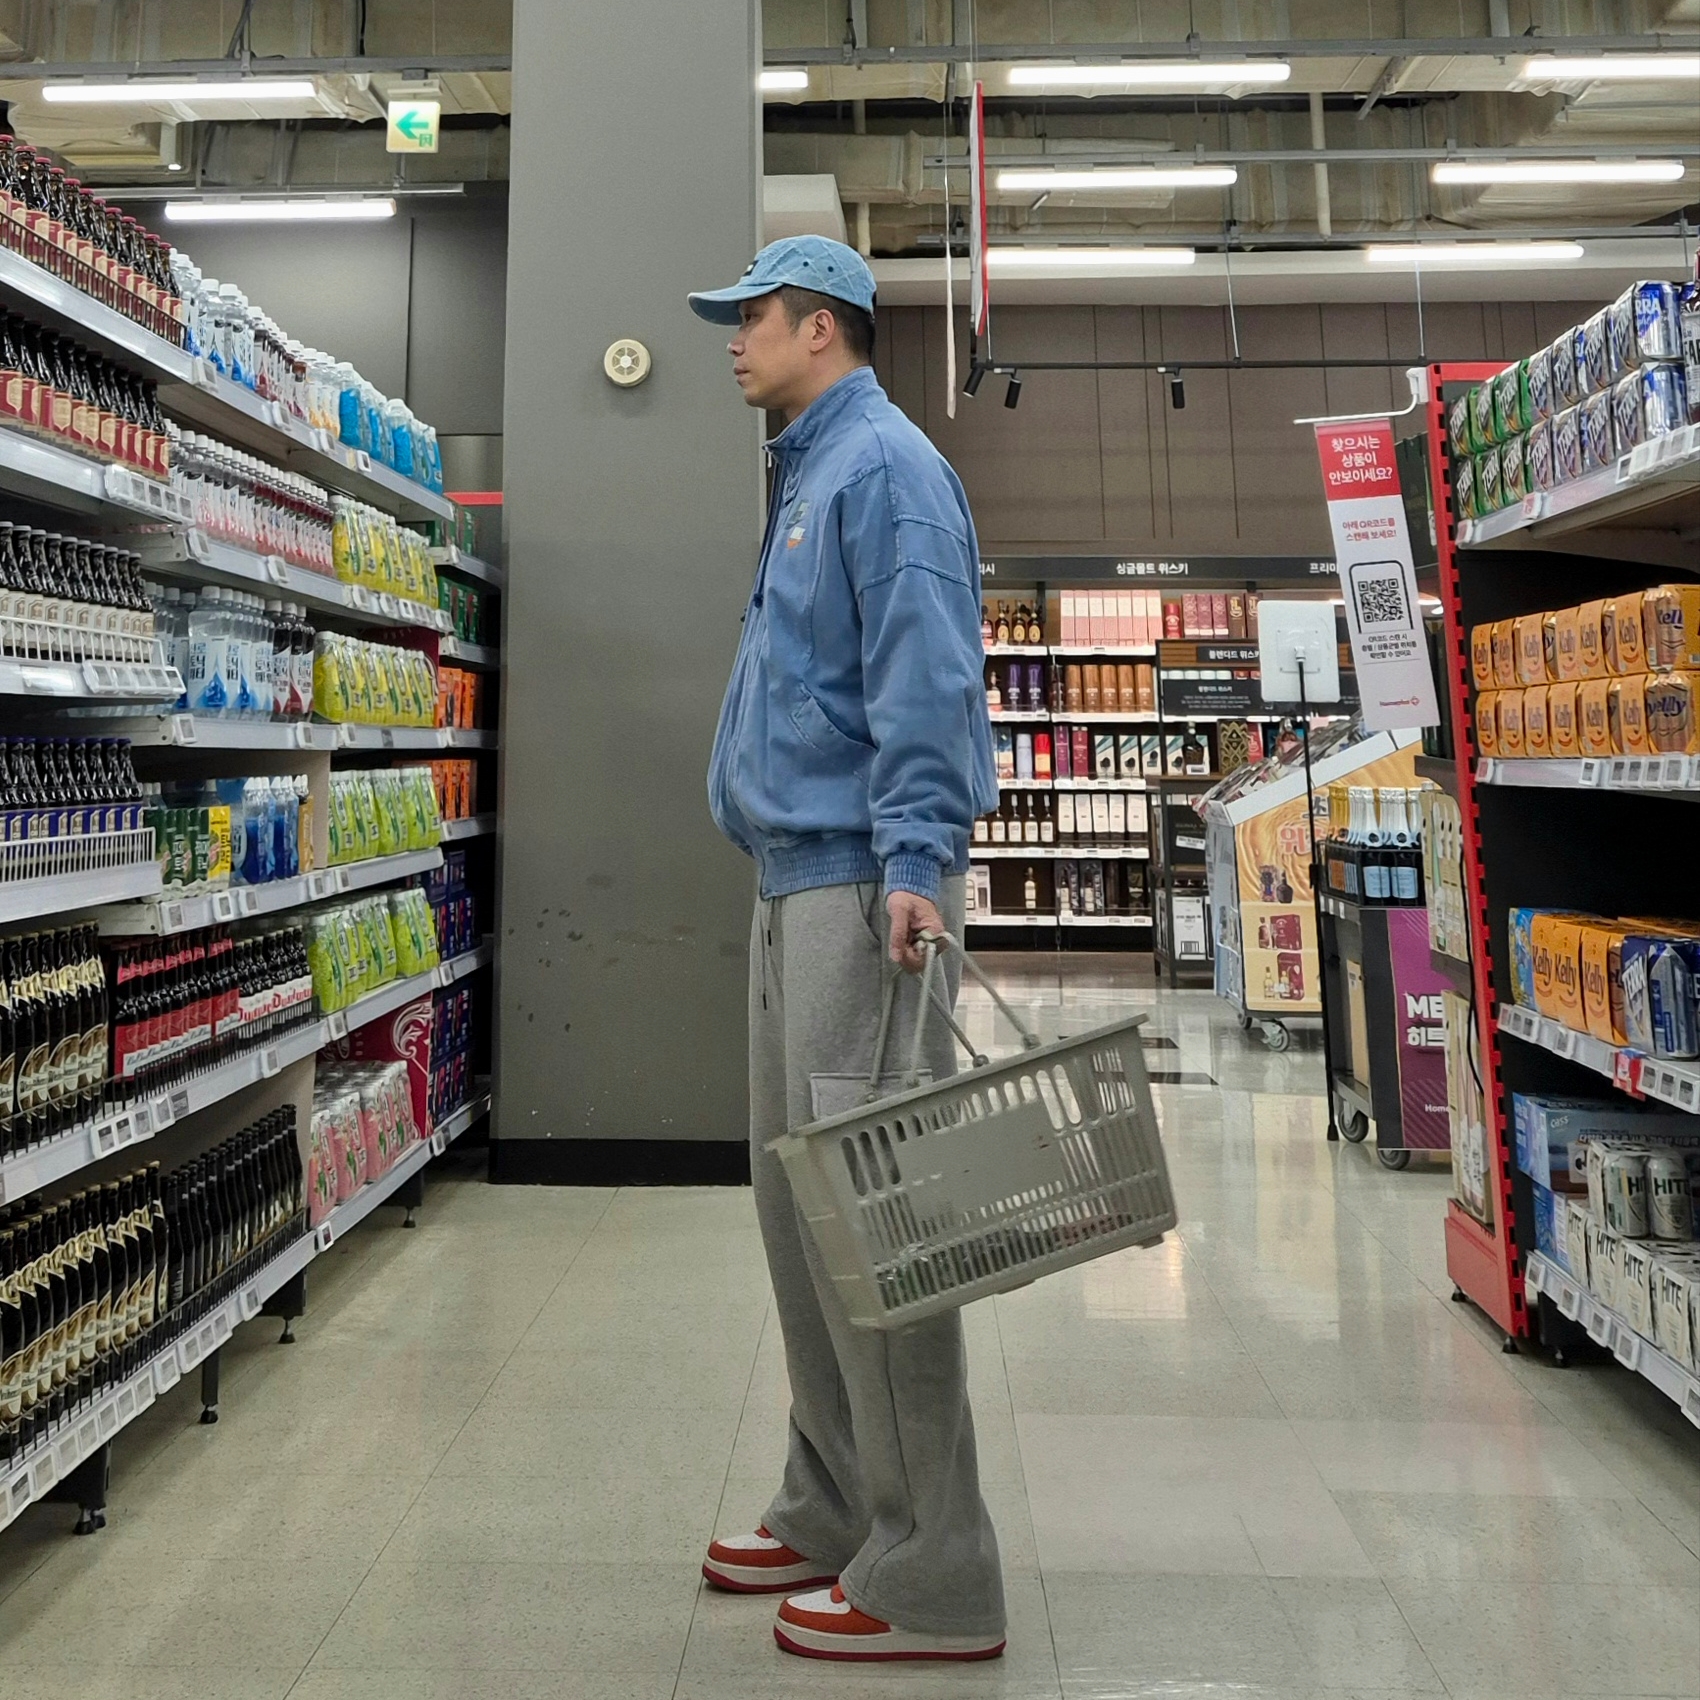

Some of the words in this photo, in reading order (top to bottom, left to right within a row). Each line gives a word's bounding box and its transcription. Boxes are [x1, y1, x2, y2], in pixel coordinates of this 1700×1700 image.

[1332, 435, 1381, 452] 찾으시는
[1342, 451, 1377, 468] 상품이
[1329, 467, 1393, 485] 안보이세요?
[1343, 520, 1359, 531] 아래
[1359, 518, 1395, 529] QR코드를
[1346, 531, 1370, 542] 스캔해
[1371, 529, 1397, 540] 보세요!
[1116, 563, 1156, 575] 싱글몰트
[1158, 563, 1189, 575] 위스키
[1619, 617, 1638, 652] Kelly
[1532, 945, 1553, 986] Kelly
[1554, 953, 1577, 996] Kelly
[1622, 956, 1646, 998] TERRA
[1584, 961, 1606, 1006] Kelly
[1569, 1214, 1581, 1241] HITE
[1597, 1231, 1616, 1264] HITE
[1624, 1251, 1644, 1286] HITE
[1662, 1272, 1683, 1313] HITE
